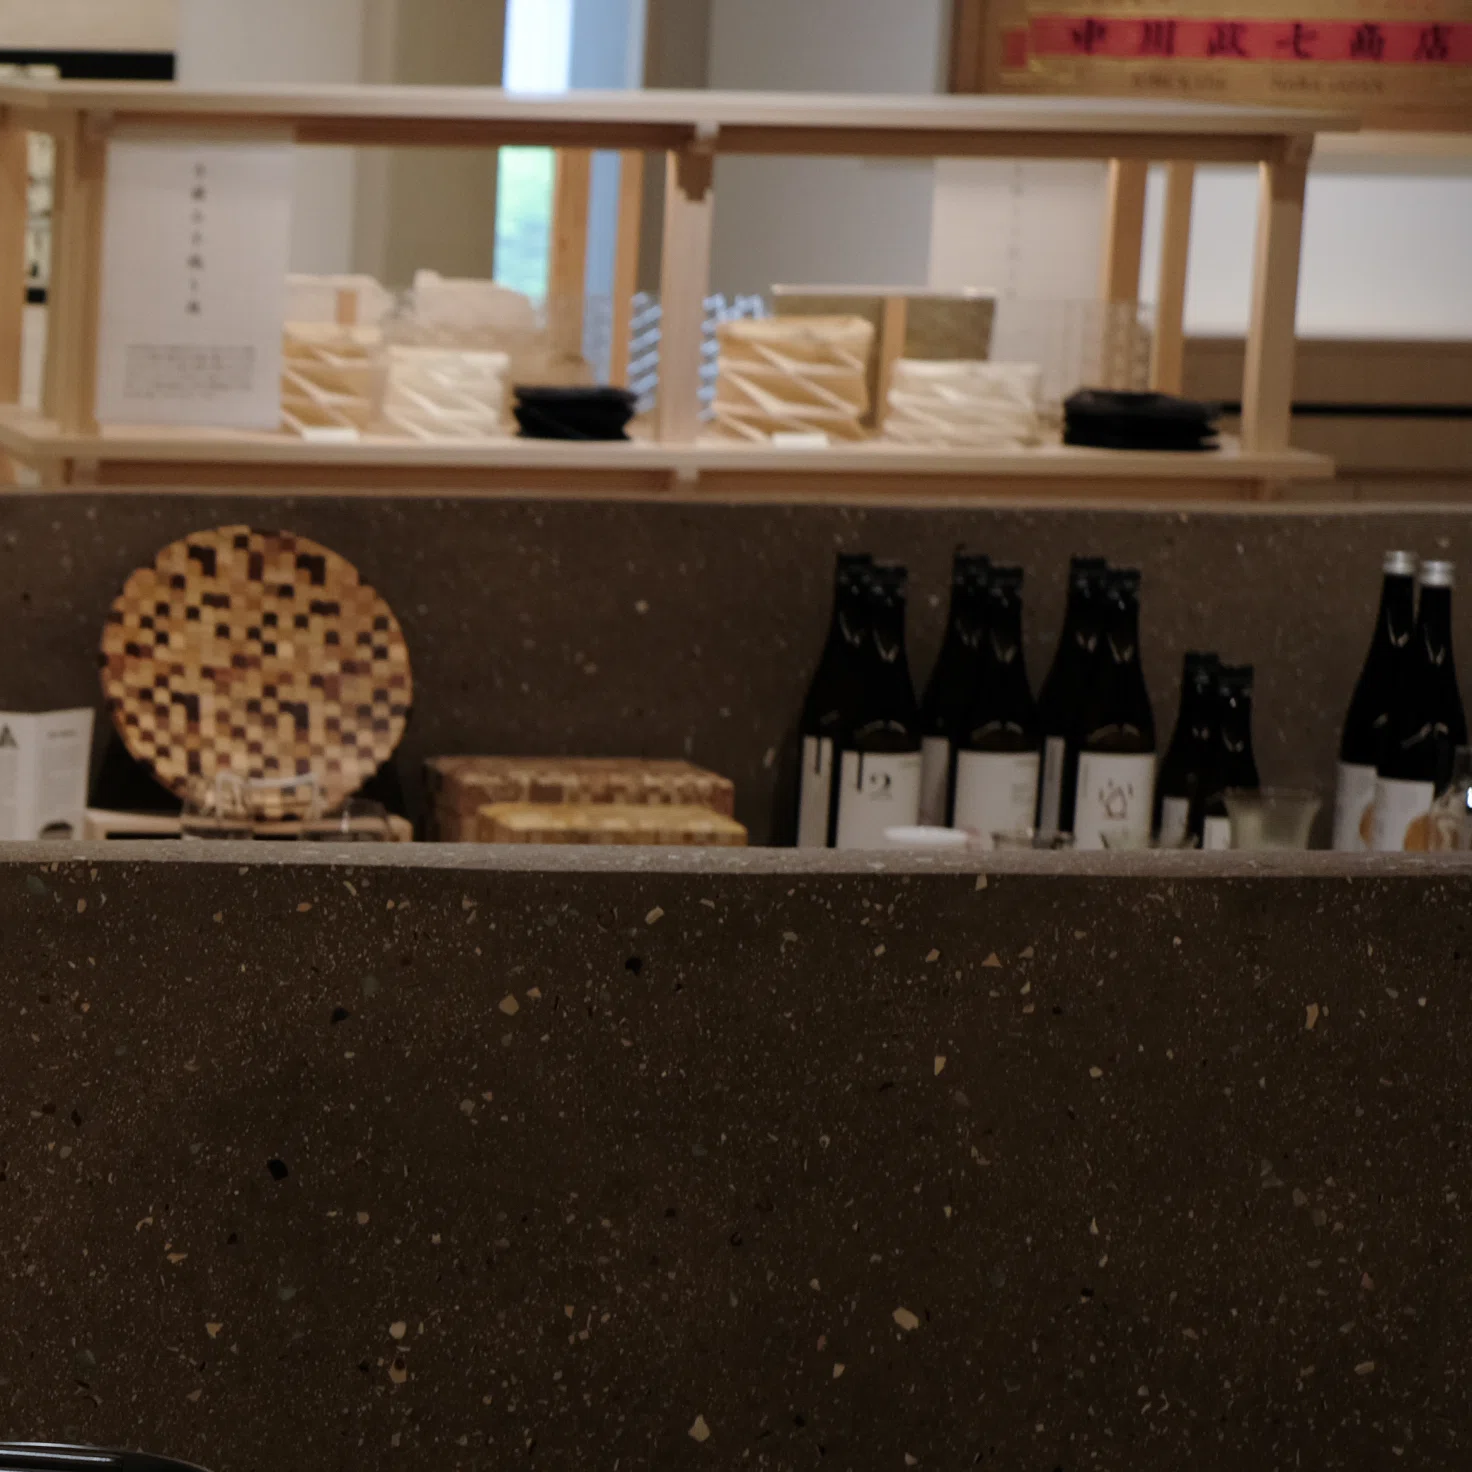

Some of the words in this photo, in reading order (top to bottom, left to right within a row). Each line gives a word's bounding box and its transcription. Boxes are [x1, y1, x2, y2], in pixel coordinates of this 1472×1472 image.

[1072, 18, 1451, 61] 中川政七商店
